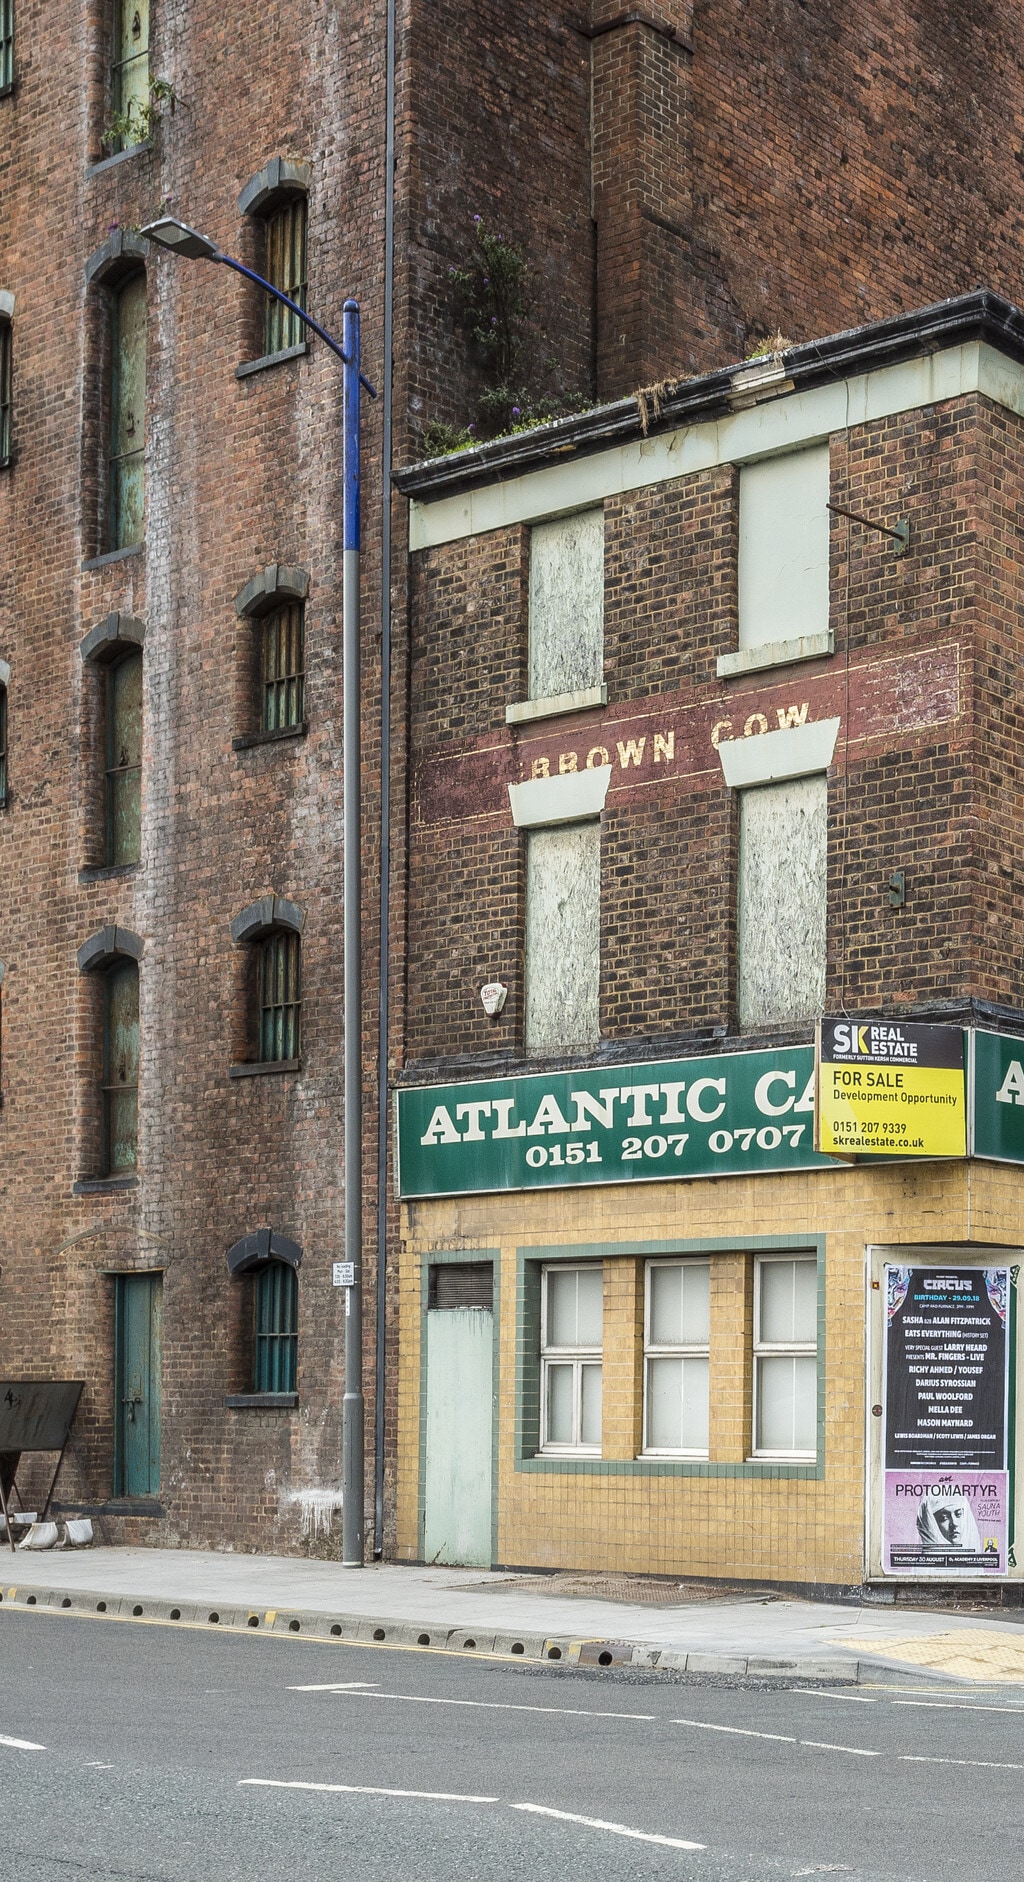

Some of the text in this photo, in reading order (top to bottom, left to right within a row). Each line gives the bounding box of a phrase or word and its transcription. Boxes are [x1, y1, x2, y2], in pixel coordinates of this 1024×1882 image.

[871, 1026, 905, 1042] REAL
[832, 1024, 869, 1054] SK
[871, 1041, 918, 1057] ESTATE
[833, 1053, 856, 1061] FORMERLY
[833, 1070, 904, 1088] FOR SALE
[833, 1089, 957, 1107] Development Opportunity
[420, 1069, 817, 1146] ATLANTIC CA
[833, 1121, 907, 1134] 0151 207 9339
[833, 1135, 924, 1148] skrealestate.co.uk
[525, 1124, 806, 1169] 0151 207 0707
[923, 1279, 972, 1291] CIRCUS
[902, 1316, 924, 1325] SASHA
[932, 1316, 950, 1325] ALAN
[951, 1317, 991, 1325] FITZPATRICK
[904, 1329, 920, 1337] EATS
[921, 1330, 961, 1338] EVERYTHING
[944, 1343, 965, 1352] LARRY
[965, 1344, 988, 1352] HEARD
[938, 1353, 965, 1361] FINGERS
[970, 1353, 985, 1361] LIVE
[908, 1365, 929, 1374] RICHY
[929, 1366, 953, 1374] AHMED
[958, 1366, 984, 1374] YOUSEF
[915, 1379, 976, 1387] DARIUS SYROSSIAN
[918, 1392, 973, 1401] PAUL WOOLFORD
[928, 1405, 963, 1414] MELLA DEE
[917, 1418, 973, 1427] MASON MAYNARD
[895, 1484, 997, 1497] PROTOMARTYR
[977, 1502, 1001, 1511] SAUNA
[977, 1510, 1001, 1518] YOUTH
